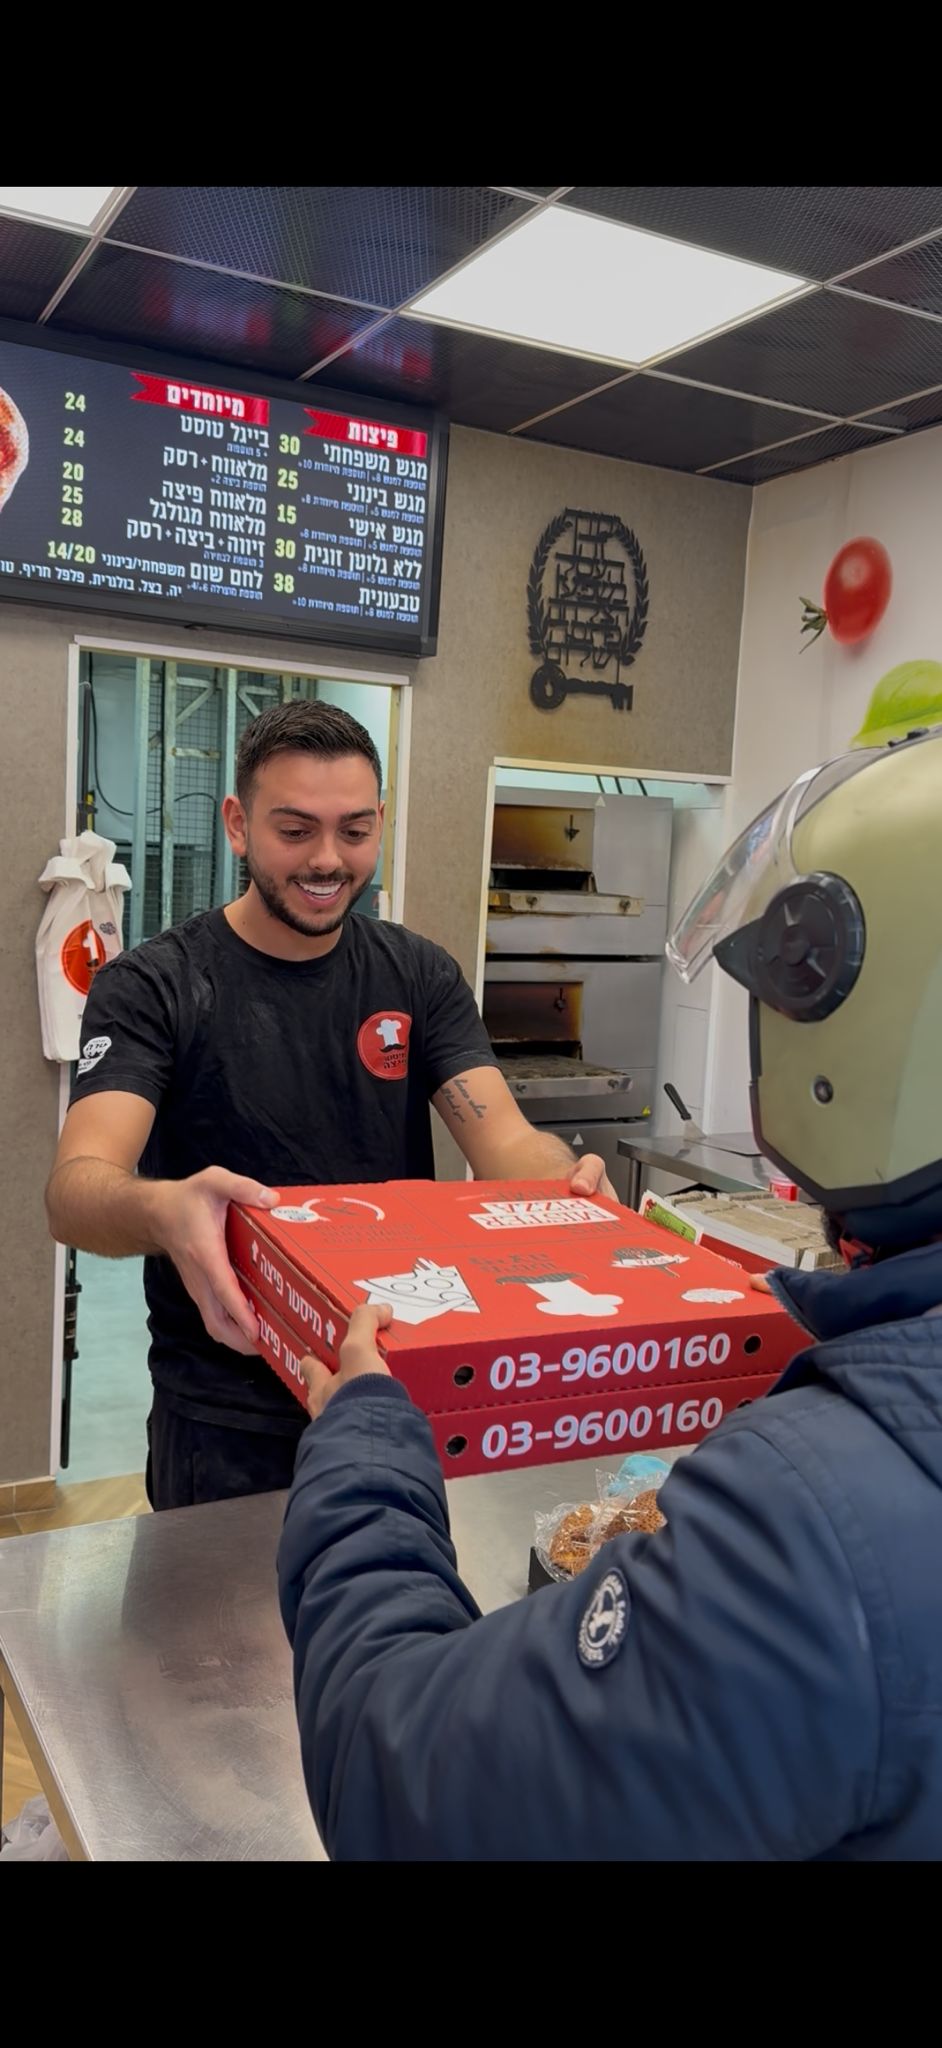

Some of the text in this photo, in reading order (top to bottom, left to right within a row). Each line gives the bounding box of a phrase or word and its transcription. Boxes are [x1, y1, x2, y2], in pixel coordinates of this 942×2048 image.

[64, 392, 86, 412] 24
[166, 384, 245, 418] מיוחדים
[64, 427, 84, 448] 24
[180, 414, 269, 448] בייגל טוסט
[348, 421, 398, 448] פיצות
[279, 434, 300, 455] 30
[164, 446, 198, 469] רסק
[212, 454, 268, 482] מלאווח
[324, 443, 428, 480] מגש משפחתי
[62, 461, 84, 482] 20
[278, 468, 298, 490] 25
[62, 485, 83, 504] 25
[162, 480, 266, 515] מלאווח פיצה
[347, 482, 426, 513] מגש בינוני
[62, 507, 82, 527] 28
[150, 498, 266, 536] מלאווח מגולגל
[277, 504, 296, 524] 15
[127, 519, 162, 541] רסק
[176, 527, 214, 550] ביצה
[349, 518, 424, 547] מגש אישי
[48, 540, 96, 564] 14/20
[274, 538, 296, 559] 30
[102, 552, 263, 589] לחם שום משפחתי/בינוני
[304, 544, 422, 580] ללא גלוטן זוגית
[55, 567, 84, 583] פלפל
[274, 572, 294, 594] 38
[358, 587, 420, 613] טבעונית
[479, 1209, 607, 1227] MISTER
[490, 1200, 590, 1214] PIZZA
[260, 1254, 322, 1338] מיסטר פיצה
[490, 1332, 731, 1390] 03-9600160
[482, 1398, 722, 1459] 03-9600160
